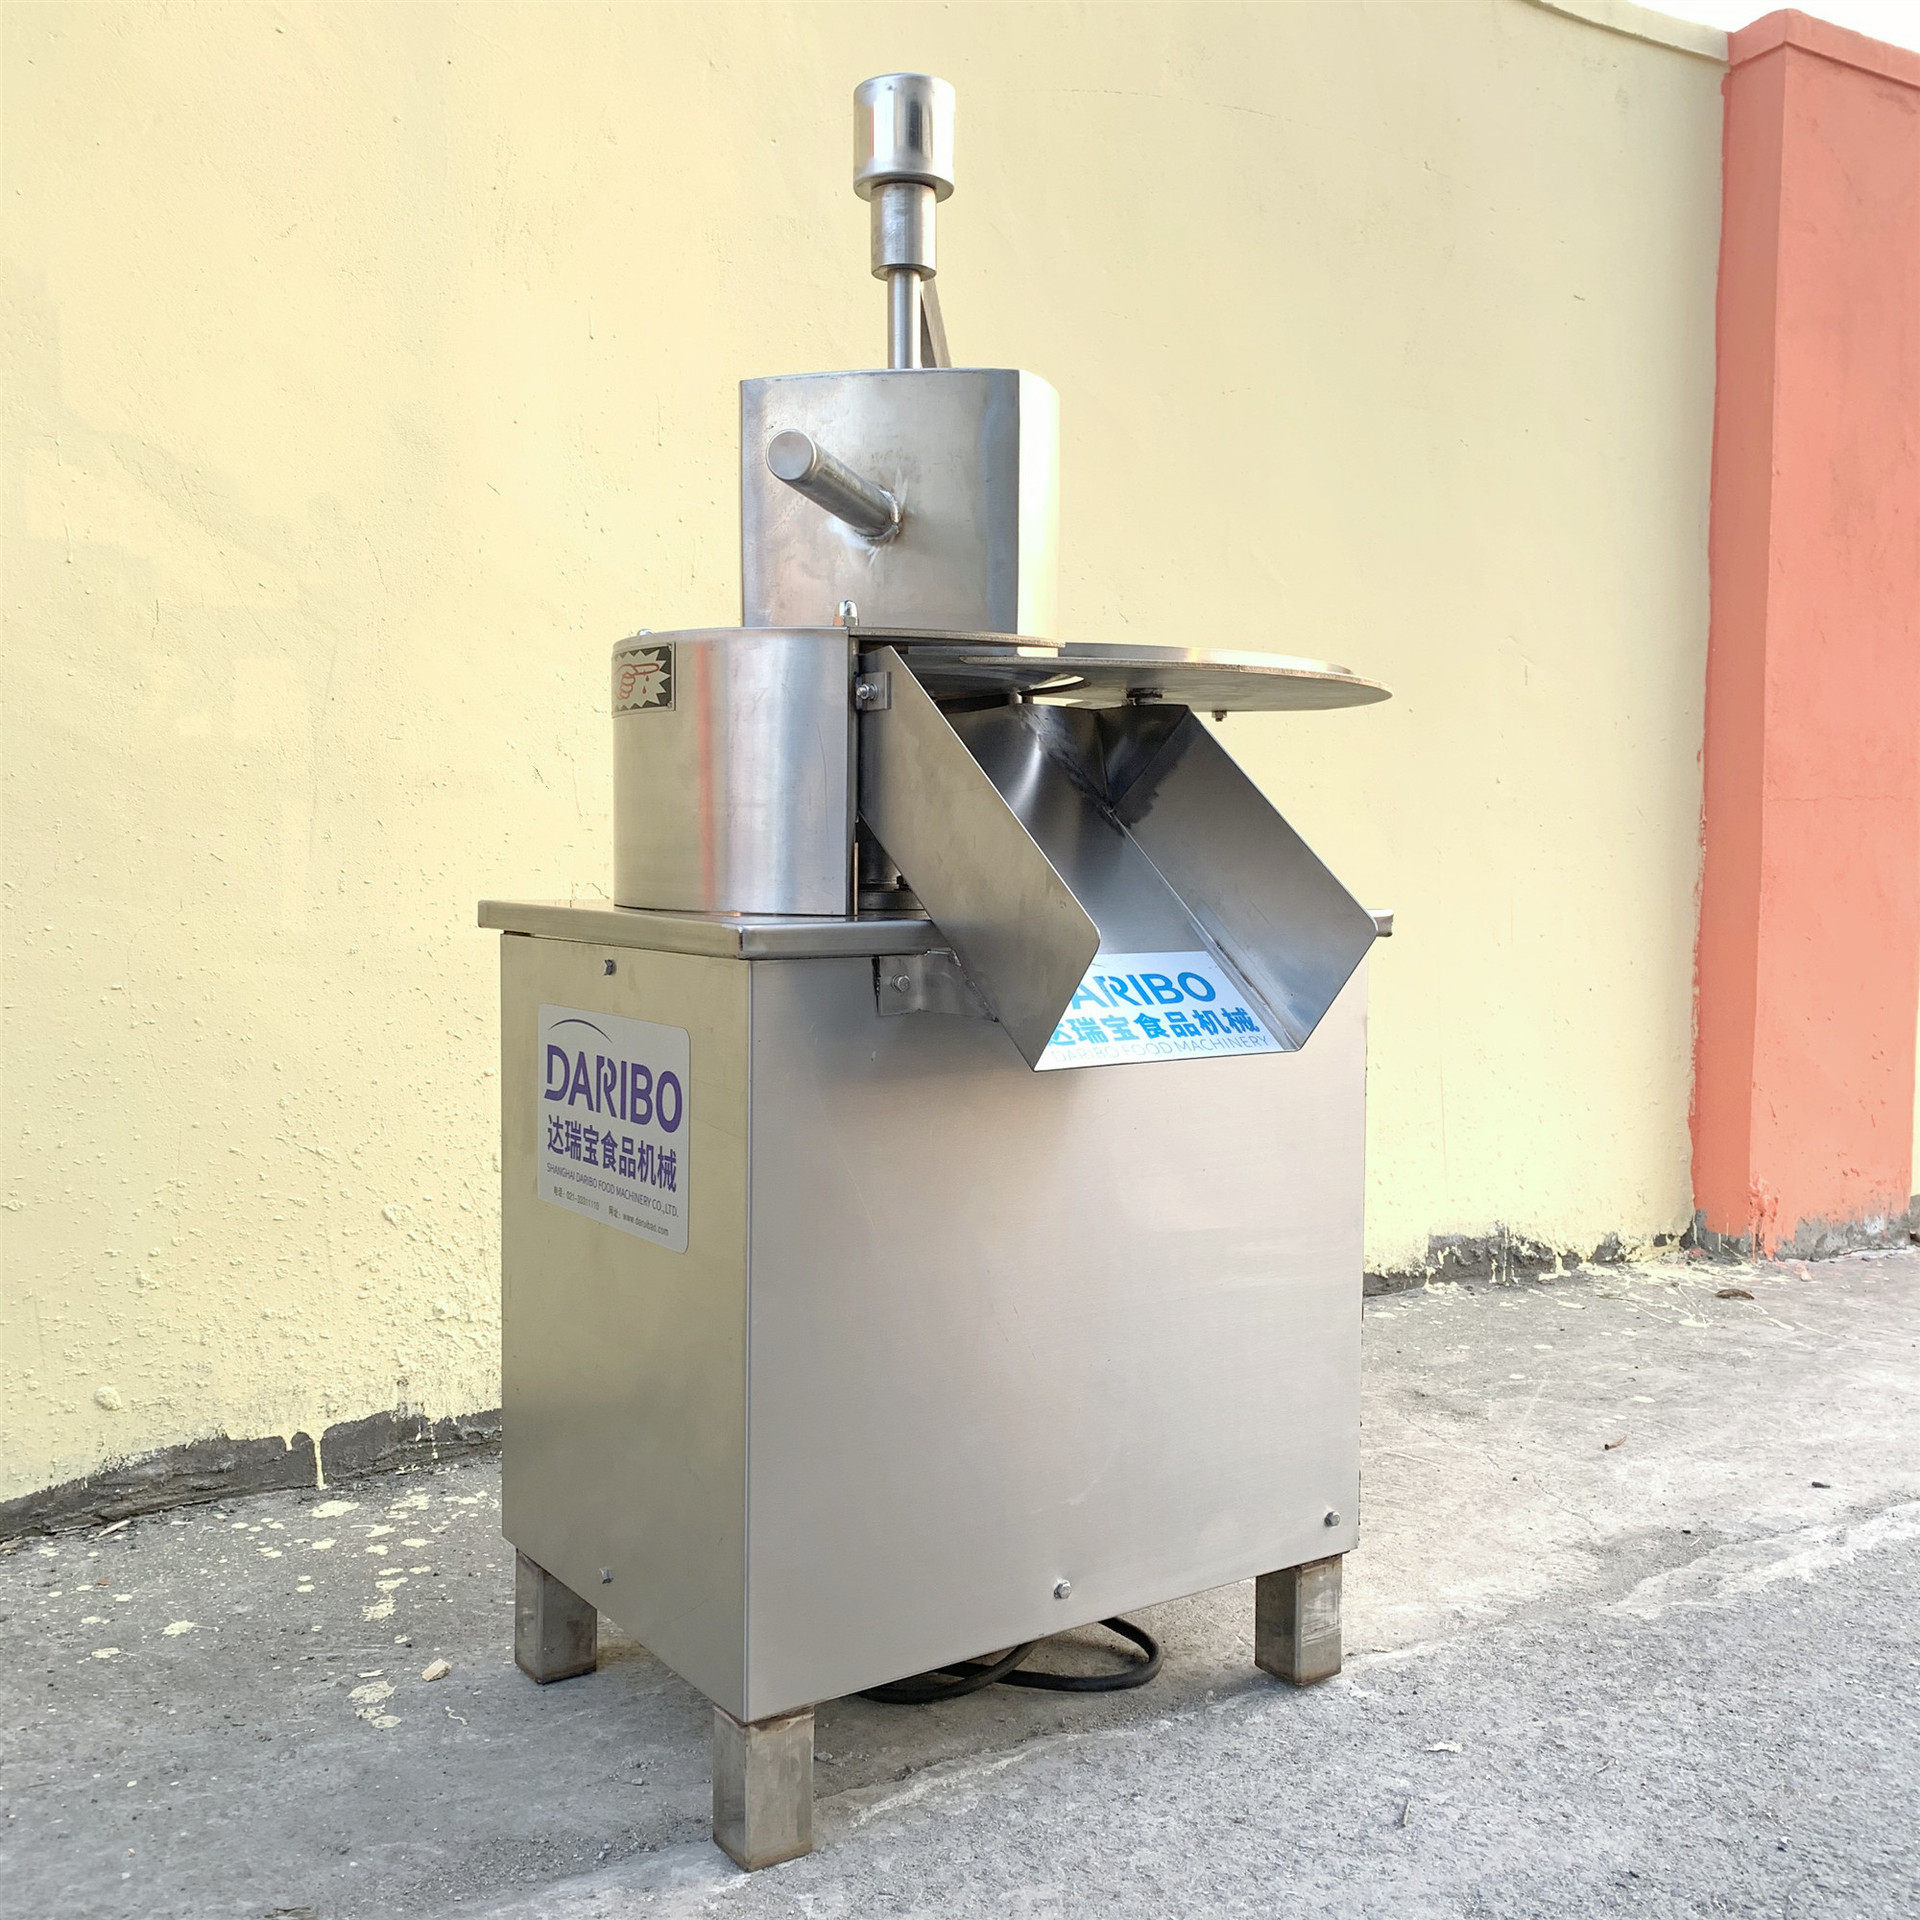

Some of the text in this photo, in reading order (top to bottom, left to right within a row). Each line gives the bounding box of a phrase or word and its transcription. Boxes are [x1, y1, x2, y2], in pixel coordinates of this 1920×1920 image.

[1071, 971, 1217, 1010] ARIBO
[1174, 1035, 1269, 1052] MACHINERY
[544, 1044, 683, 1134] DARIBO
[547, 1114, 677, 1193] 达瑞宝食品机械
[546, 1162, 575, 1180] SHANGHAI
[576, 1172, 598, 1189] DARIBO
[598, 1180, 615, 1194] FOOD
[616, 1185, 651, 1207] MACHINERY
